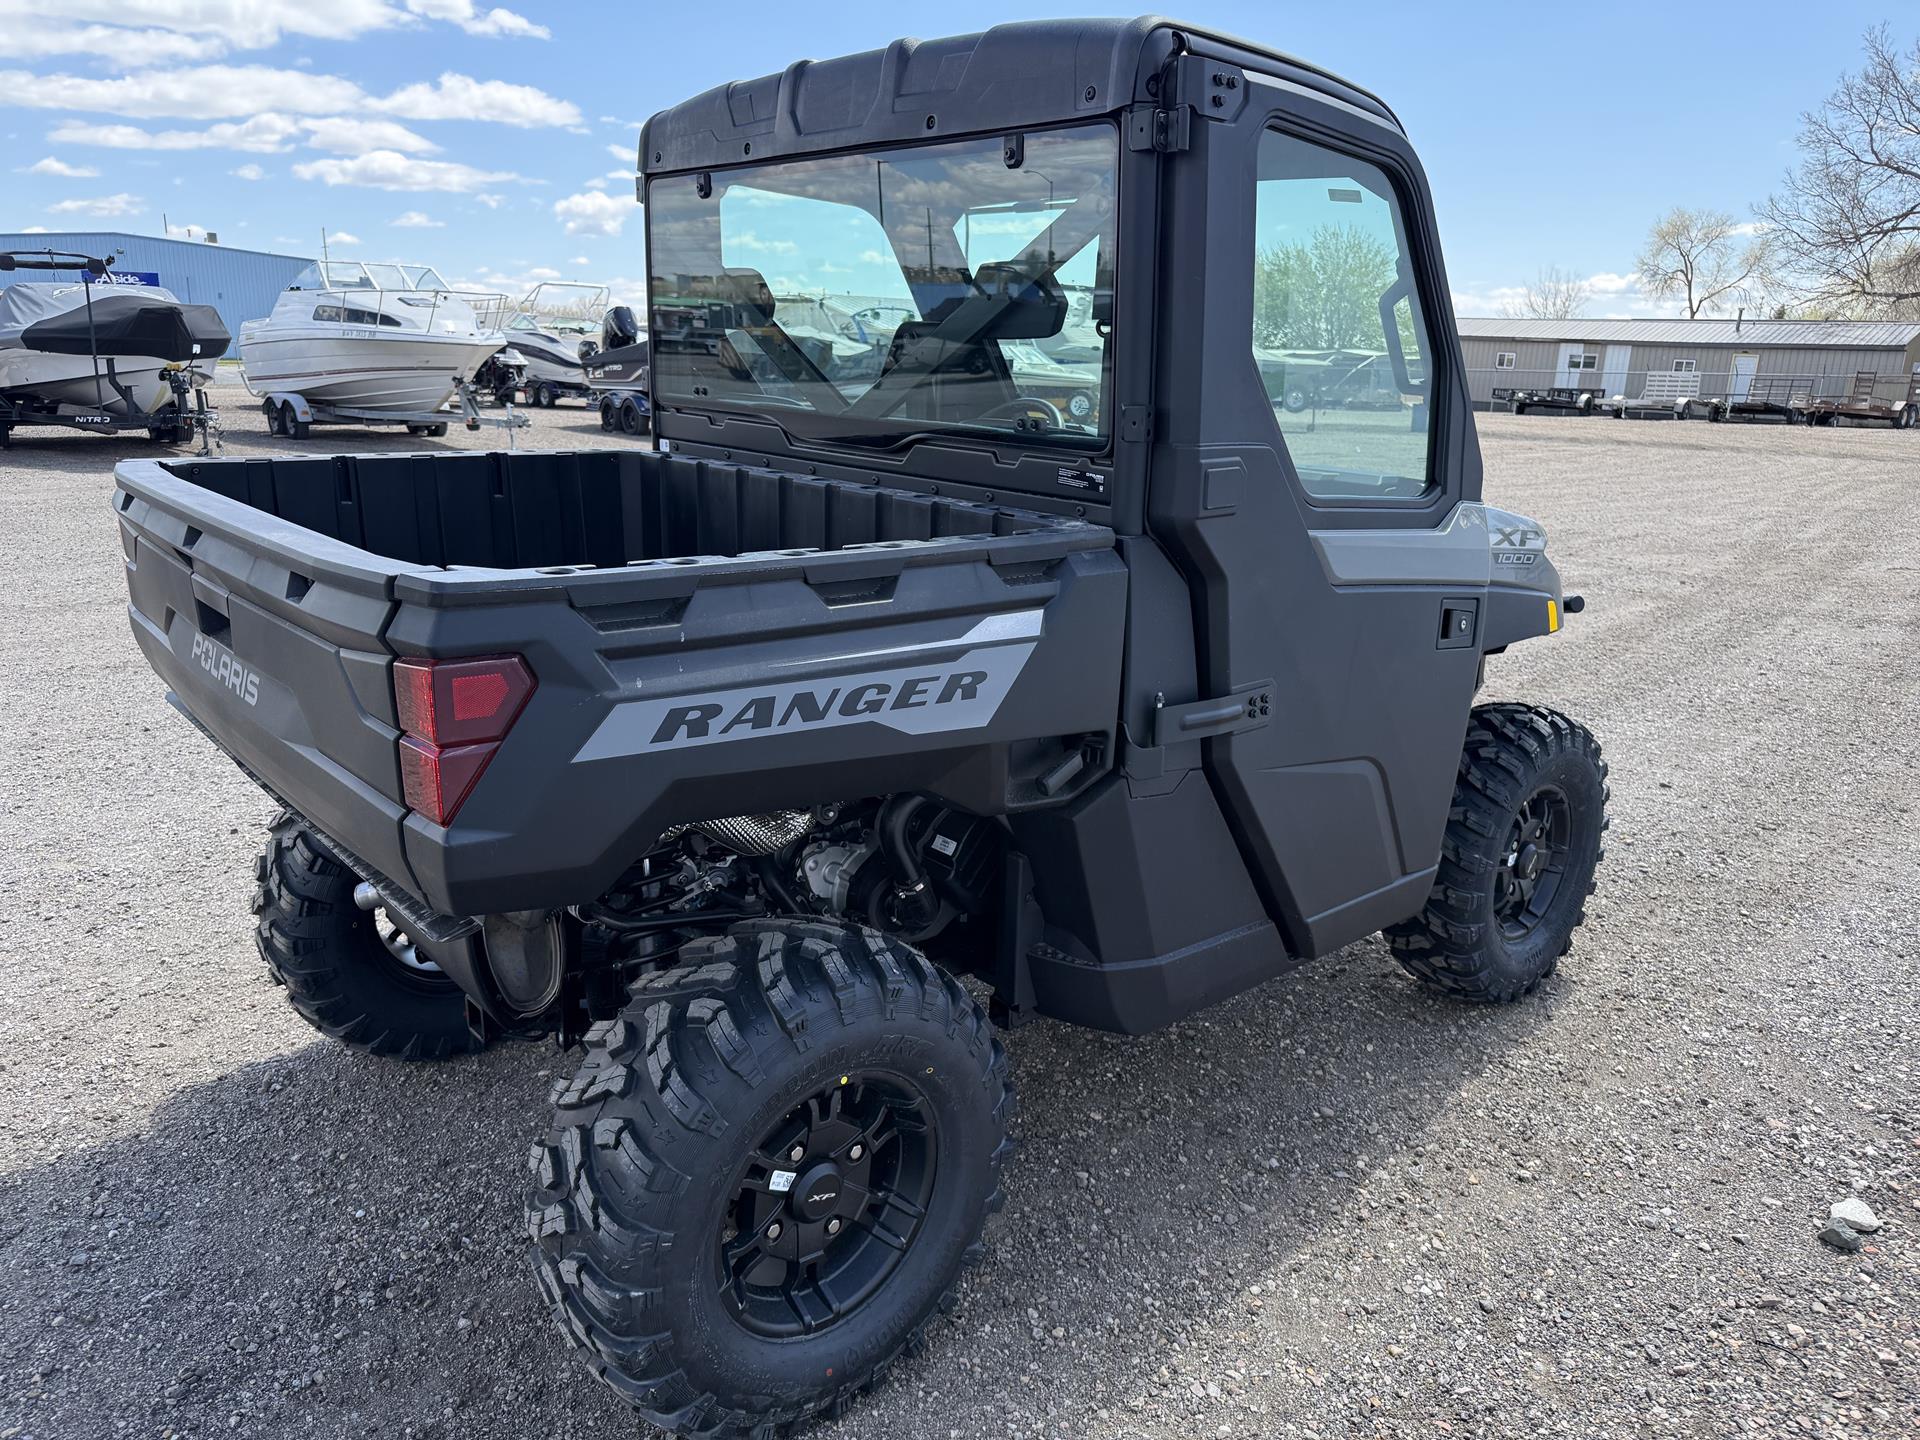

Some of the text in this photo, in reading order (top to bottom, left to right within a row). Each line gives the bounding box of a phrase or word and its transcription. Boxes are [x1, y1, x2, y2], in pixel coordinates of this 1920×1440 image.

[1492, 528, 1541, 547] XP
[1497, 553, 1535, 564] 1000
[192, 632, 260, 706] POLARIS
[649, 670, 988, 745] RANGER
[808, 1192, 836, 1202] XP
